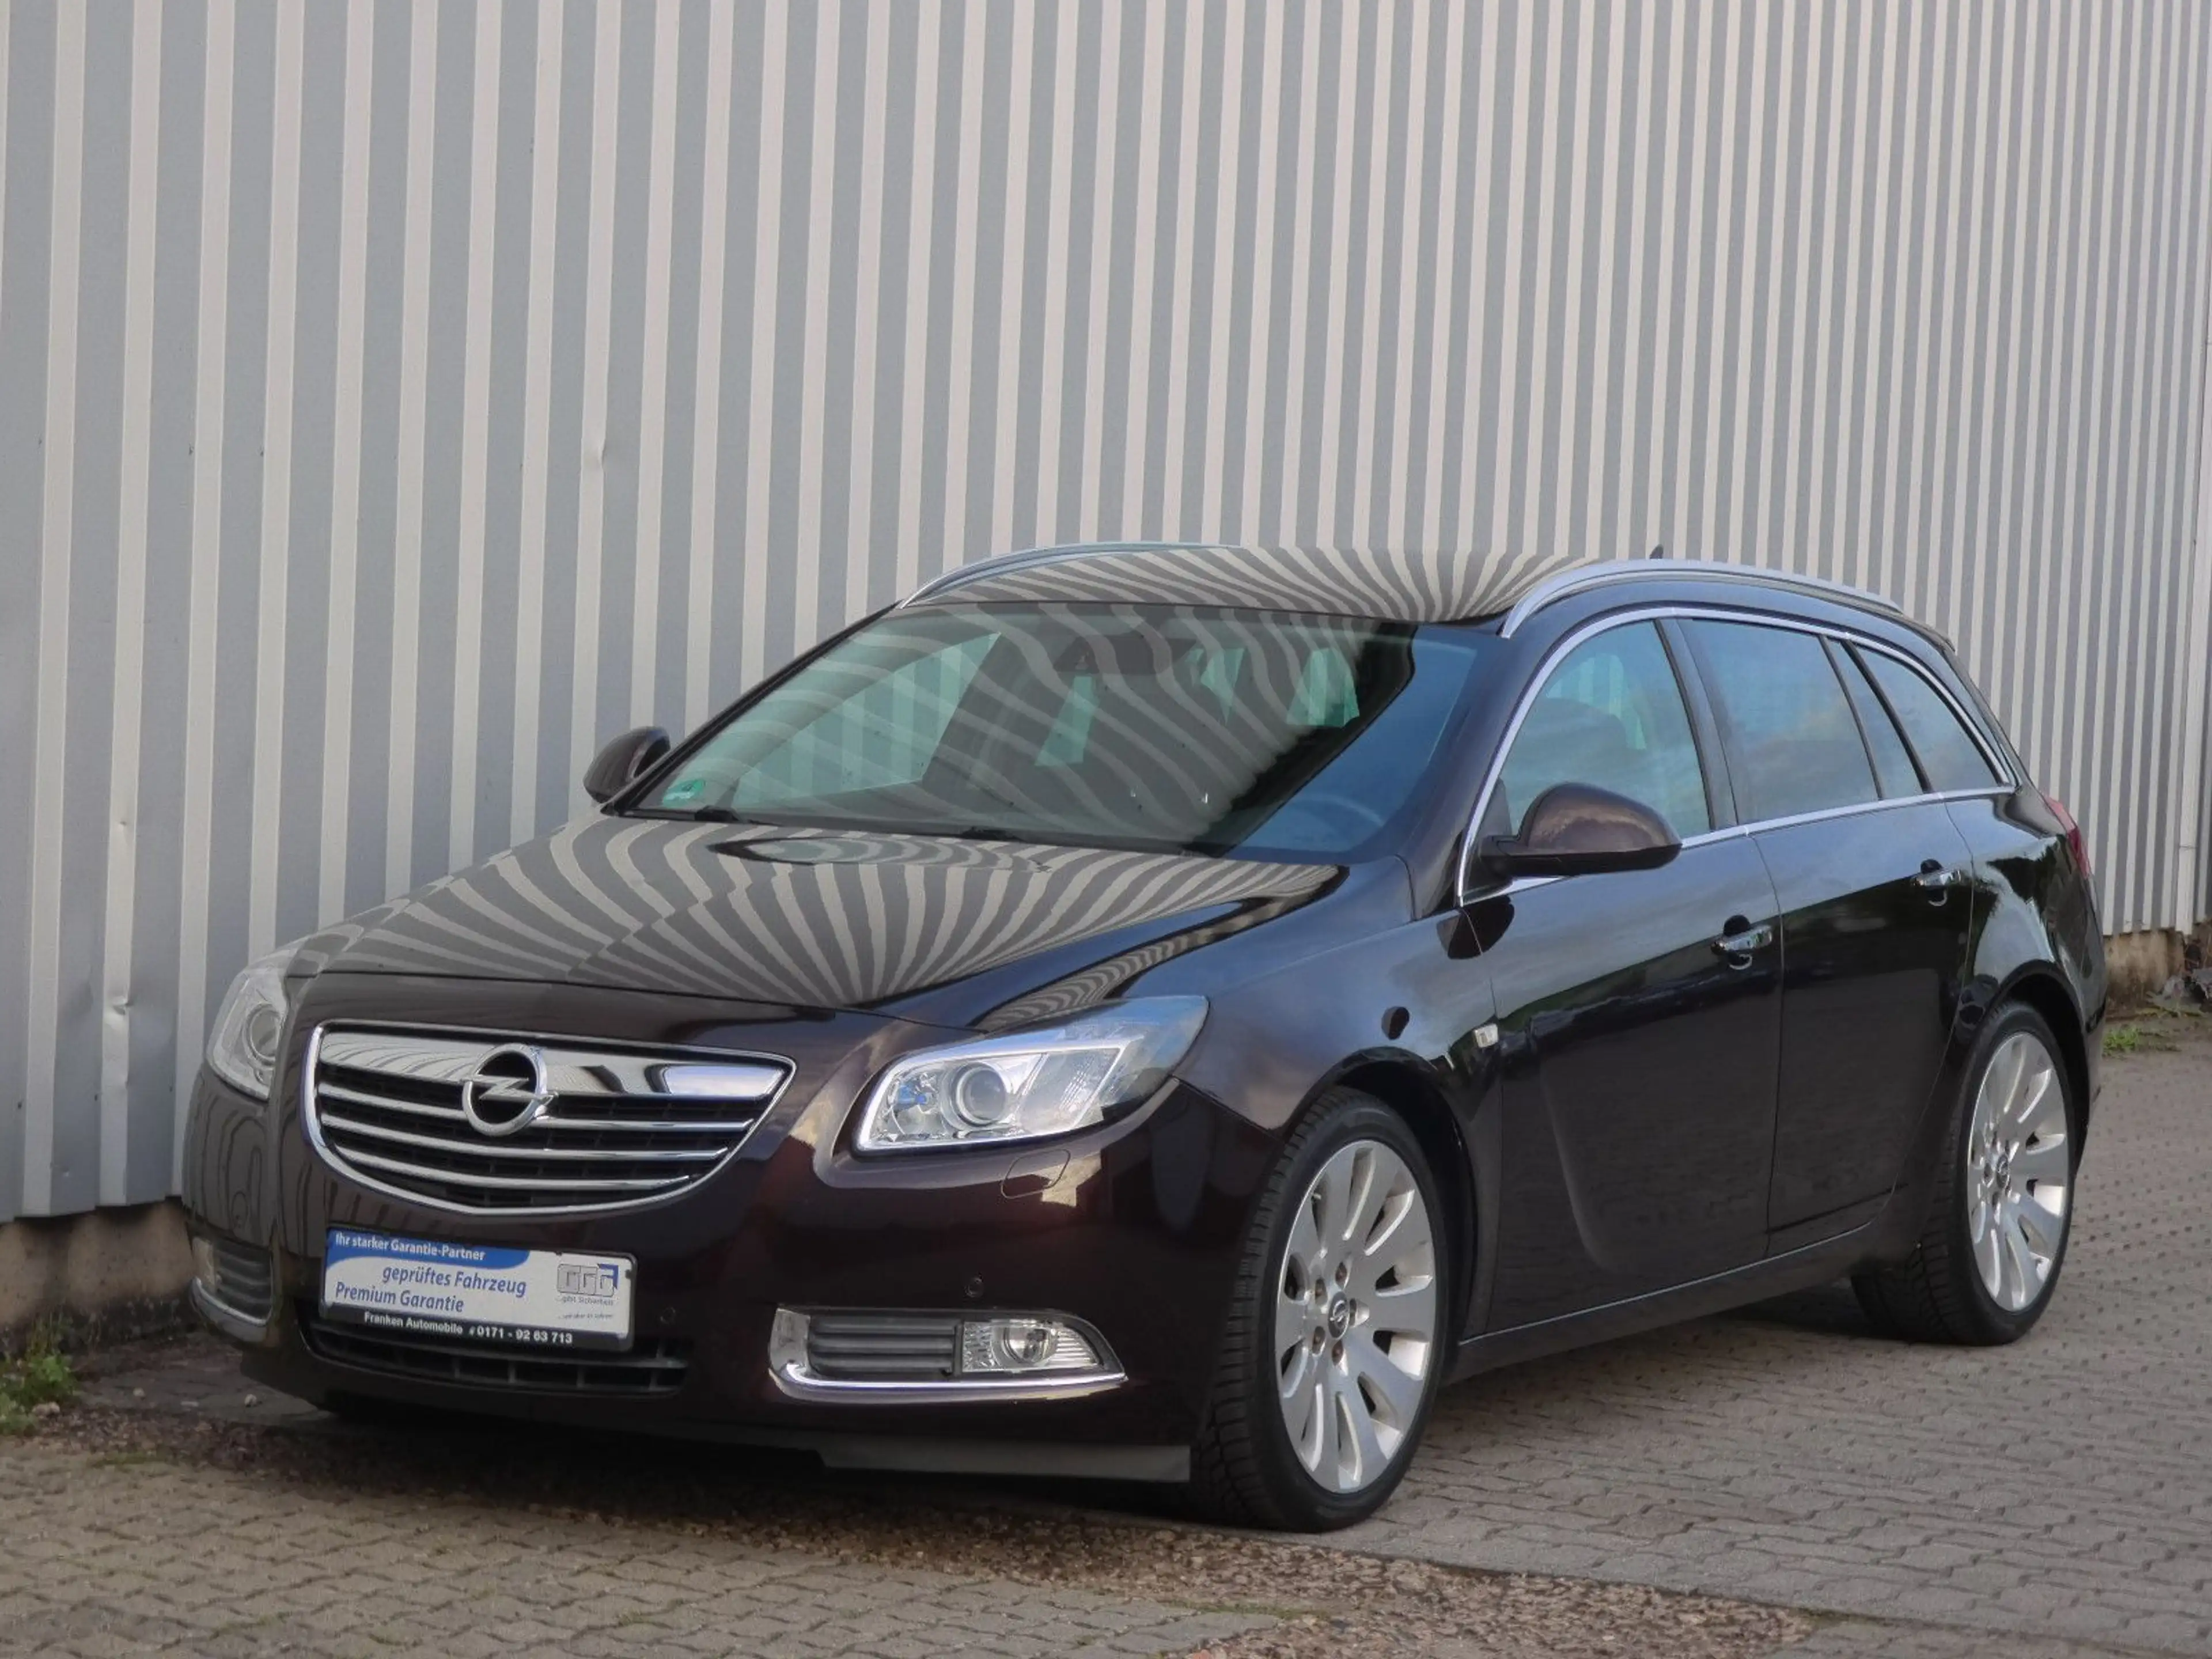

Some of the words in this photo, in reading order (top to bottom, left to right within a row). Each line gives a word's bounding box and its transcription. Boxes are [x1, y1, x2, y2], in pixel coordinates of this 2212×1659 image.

[336, 1233, 349, 1246] Ihr
[352, 1237, 390, 1251] starker
[391, 1240, 485, 1260] Garantie-Partner
[382, 1266, 450, 1286] geprüftes
[454, 1271, 527, 1297] Fahrzeug
[336, 1282, 396, 1305] Premium
[400, 1290, 464, 1312] Garantie
[364, 1311, 403, 1327] Franken
[406, 1317, 463, 1335] Automobile
[477, 1325, 504, 1339] 0171
[551, 1331, 573, 1344] 713
